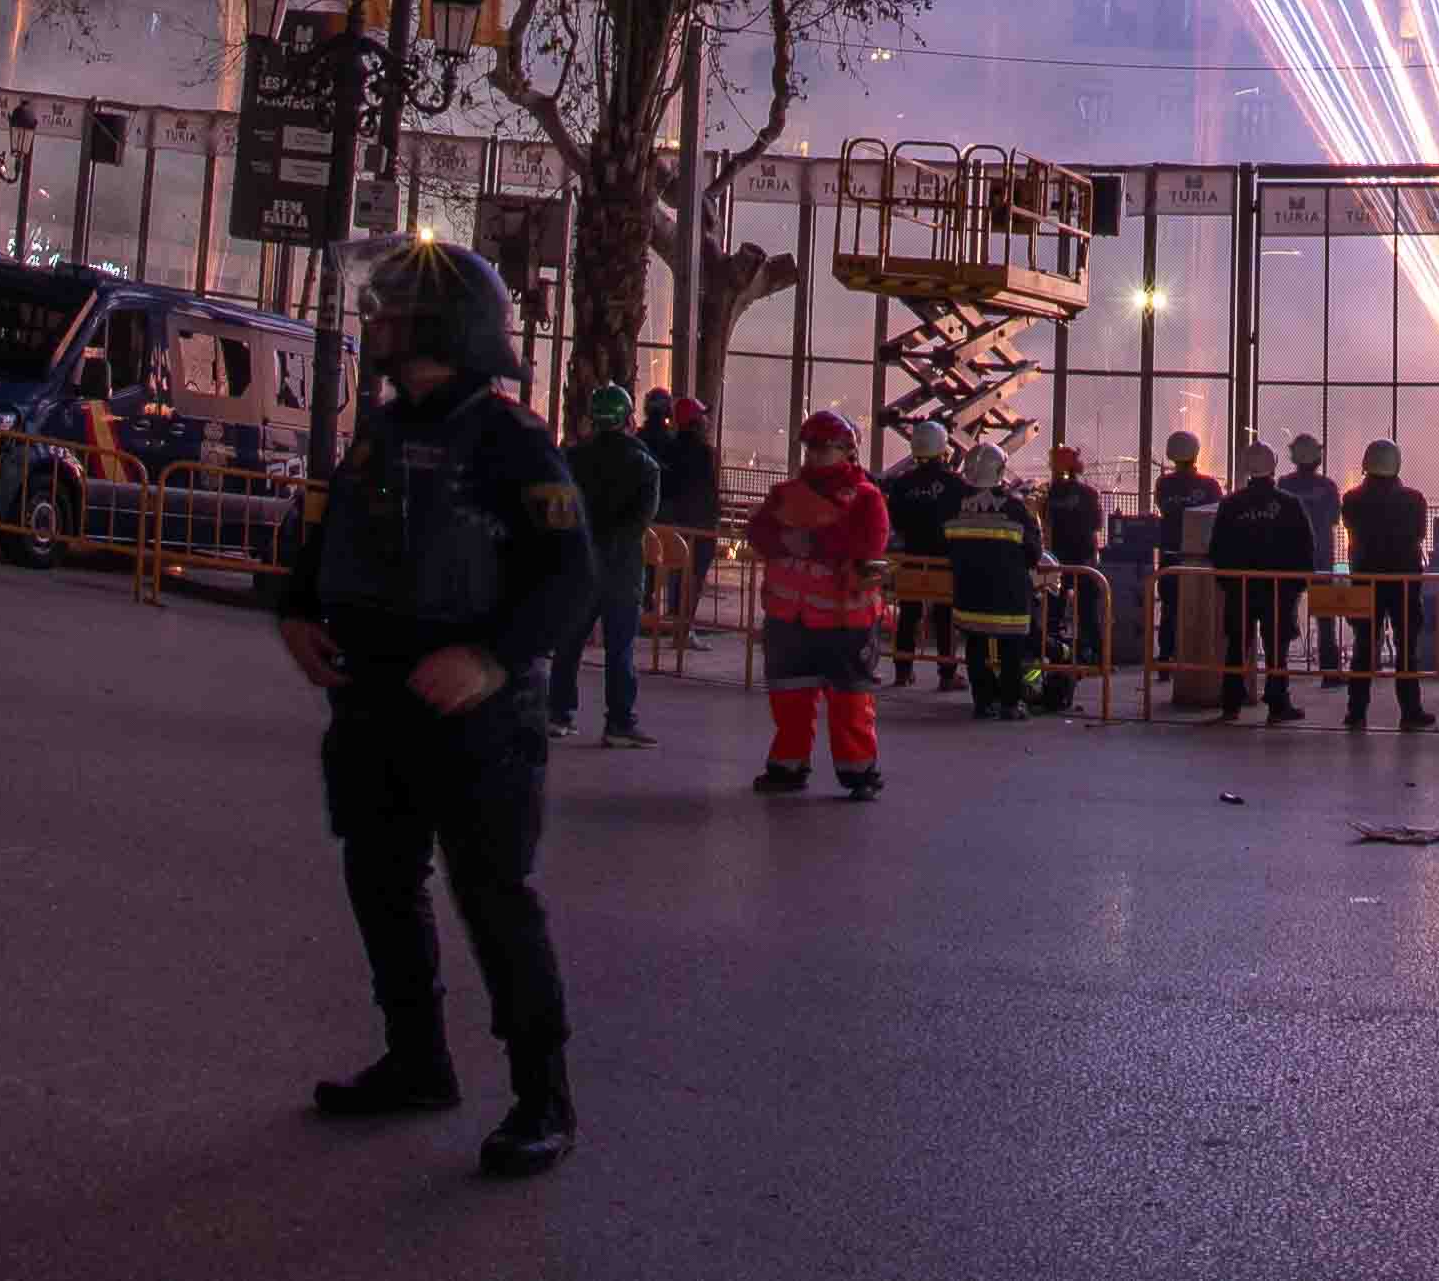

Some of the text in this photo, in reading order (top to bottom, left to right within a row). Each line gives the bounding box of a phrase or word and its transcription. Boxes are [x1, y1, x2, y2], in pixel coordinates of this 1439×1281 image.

[748, 176, 792, 192] TURIA
[1169, 190, 1218, 204] TURIA
[1274, 210, 1320, 223] TURIA
